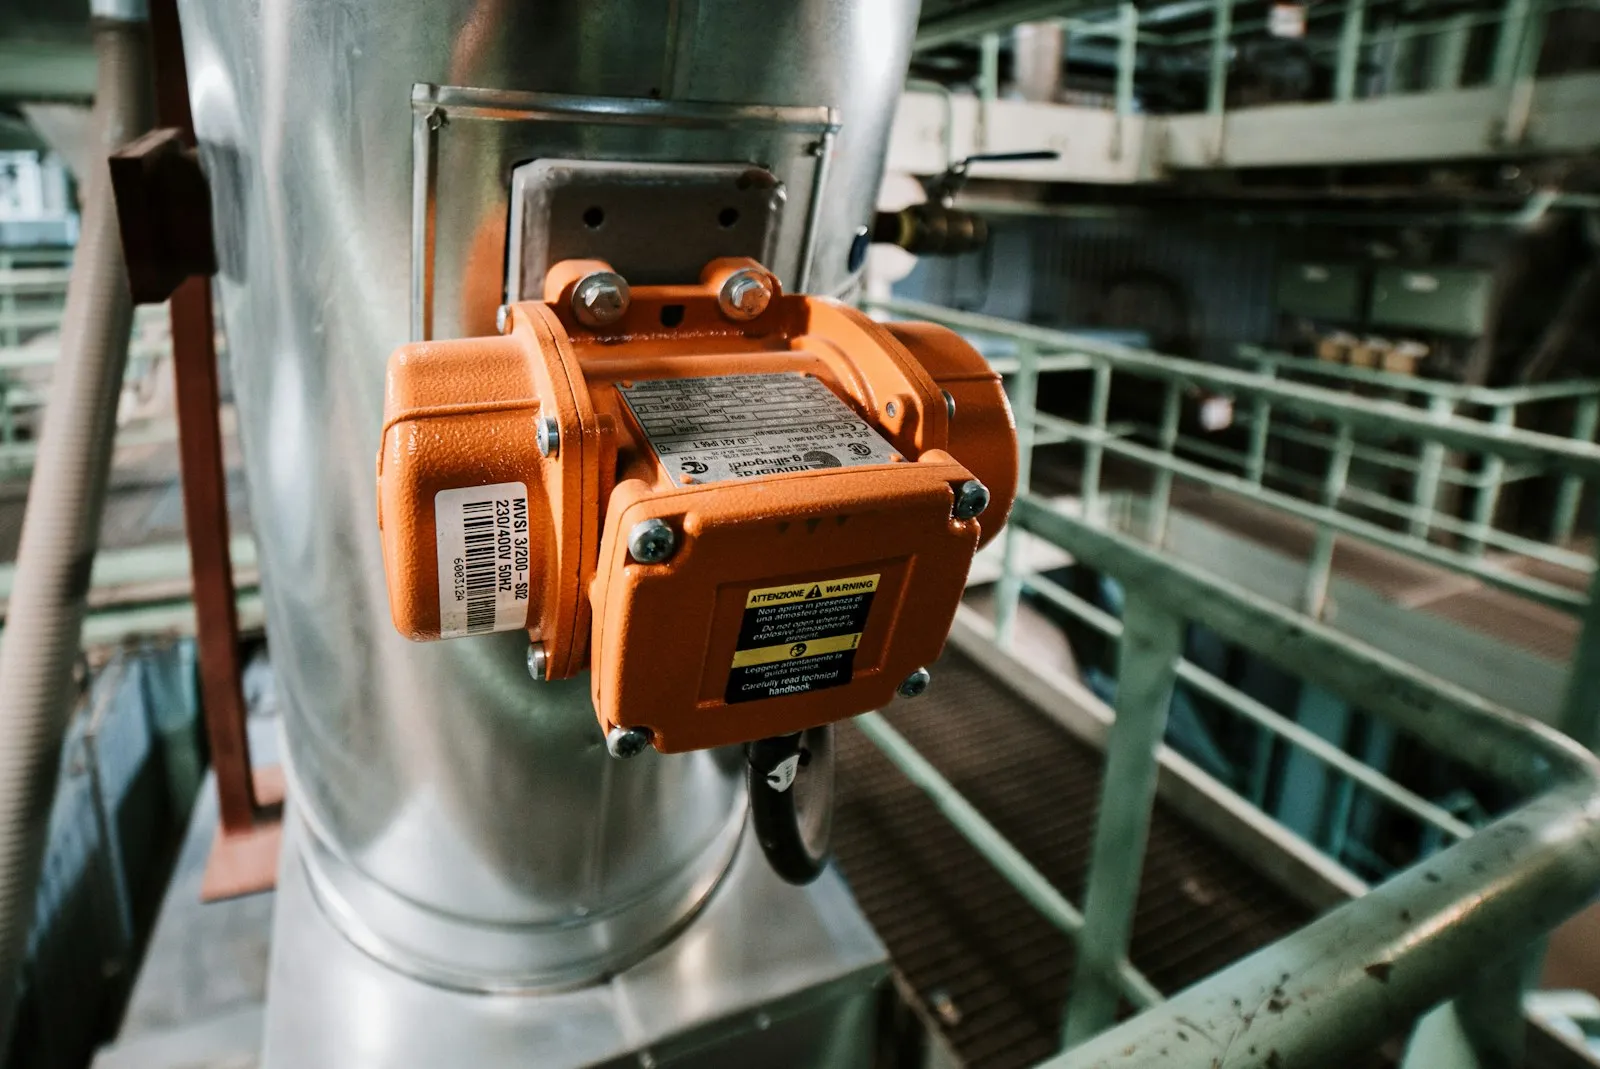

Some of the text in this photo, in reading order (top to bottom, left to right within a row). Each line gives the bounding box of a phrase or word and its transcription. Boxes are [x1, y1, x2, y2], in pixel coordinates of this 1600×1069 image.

[698, 439, 720, 447] IP66
[718, 438, 737, 446] A21
[513, 498, 526, 532] MVSI
[496, 500, 512, 592] 230/400V 50HZ
[514, 538, 528, 571] 3/200
[454, 558, 464, 601] 600312A
[515, 582, 528, 600] S02
[751, 581, 873, 603] ATTENZIONE WARNING
[775, 609, 817, 620] atmosfera
[819, 603, 859, 616] esplosiva.
[778, 604, 802, 614] aprire
[815, 598, 853, 609] presenza
[753, 629, 794, 641] explosive
[796, 621, 845, 634] atmosphere
[762, 624, 774, 632] Do
[776, 622, 790, 630] not
[792, 619, 814, 630] open
[816, 616, 838, 624] when
[785, 632, 819, 643] present.
[745, 663, 779, 675] Leggere
[781, 655, 834, 669] attentamente
[764, 663, 819, 679] guida tecnica.
[742, 670, 838, 691] Carefully read technical
